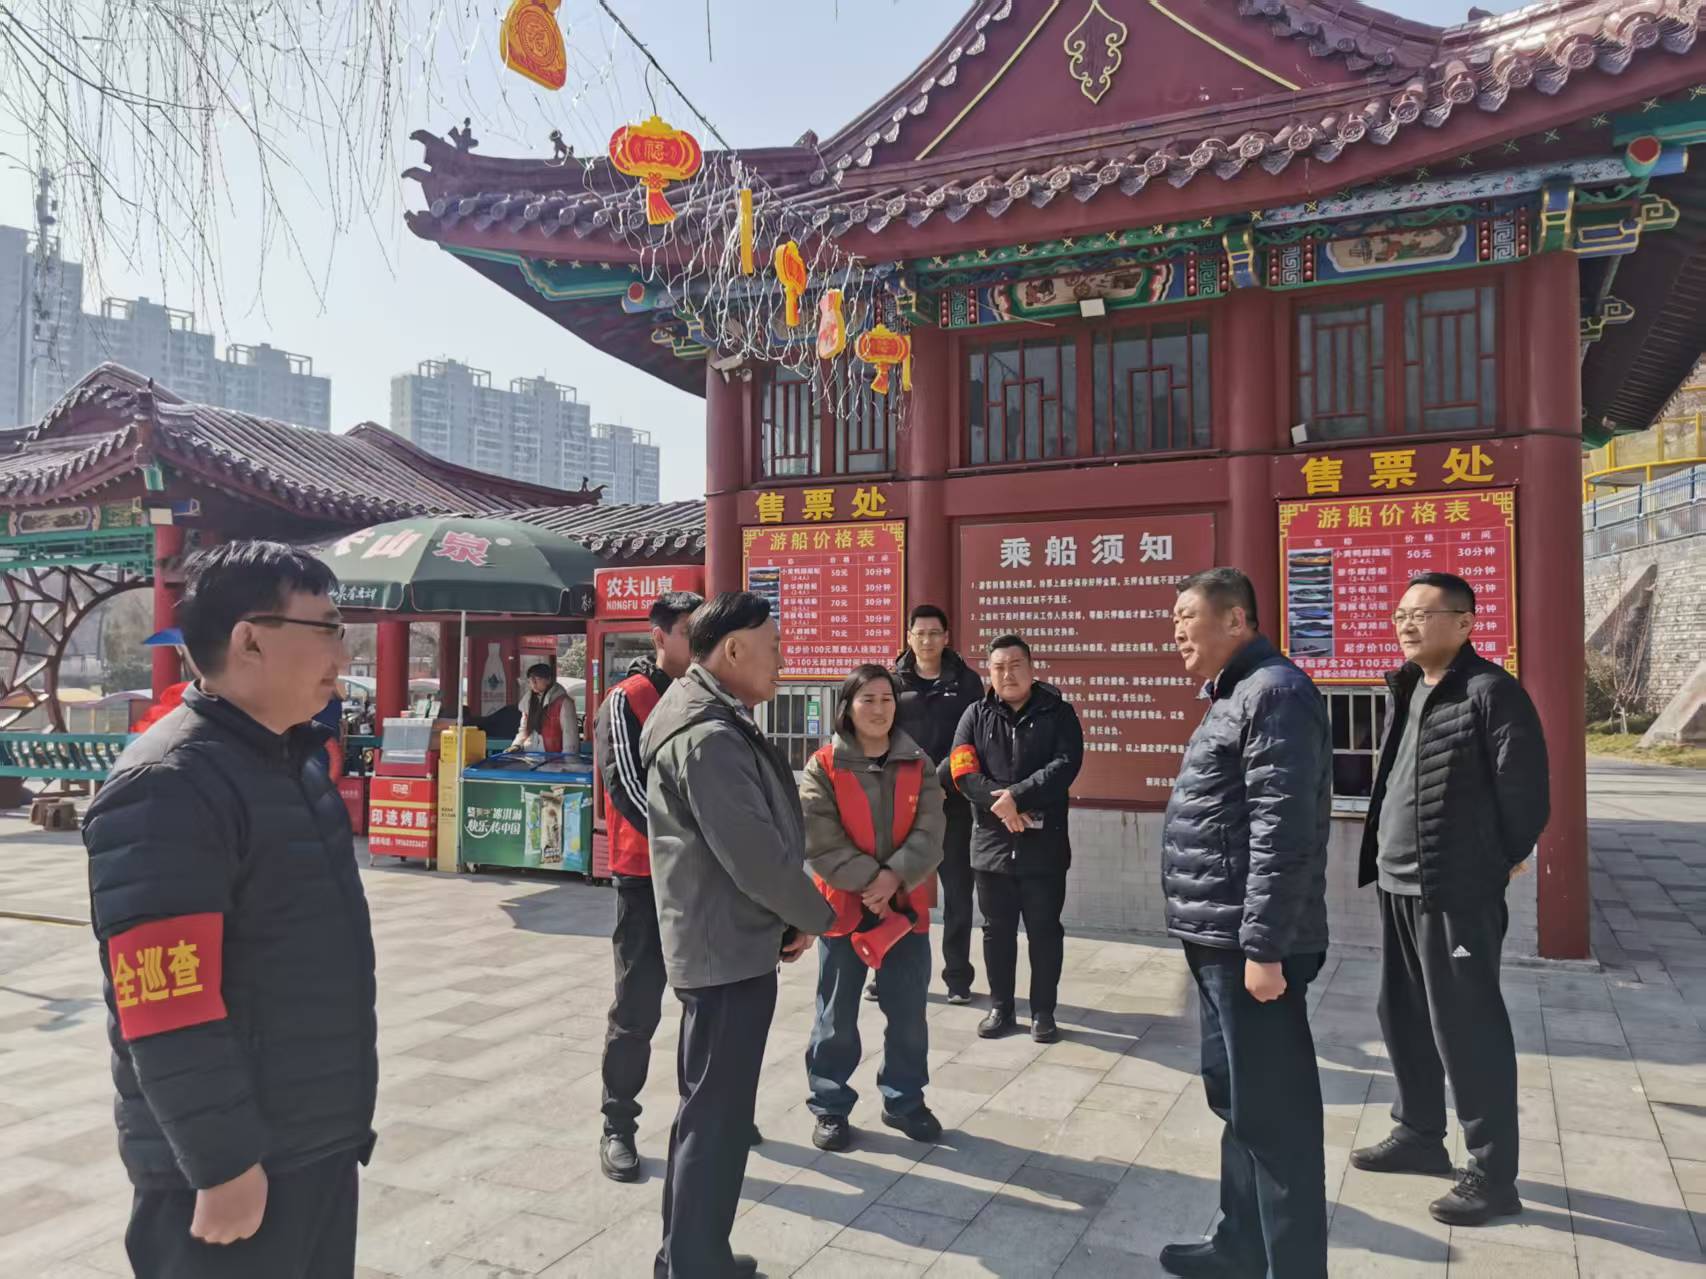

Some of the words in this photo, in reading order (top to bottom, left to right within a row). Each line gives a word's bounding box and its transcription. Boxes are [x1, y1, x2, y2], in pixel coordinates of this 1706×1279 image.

[1301, 445, 1496, 495] 售票处
[755, 486, 887, 523] 售票处
[1317, 500, 1472, 529] 游船价格表
[769, 528, 876, 551] 游船价格表
[1000, 532, 1173, 569] 乘船须知
[1407, 549, 1432, 559] 50元
[1457, 546, 1495, 557] 30分钟
[1458, 566, 1496, 576] 30分钟
[607, 576, 673, 597] 农夫山泉
[606, 599, 638, 610] NONGFU
[371, 808, 428, 828] 印迹烤肠
[113, 939, 203, 1009] 全巡查
